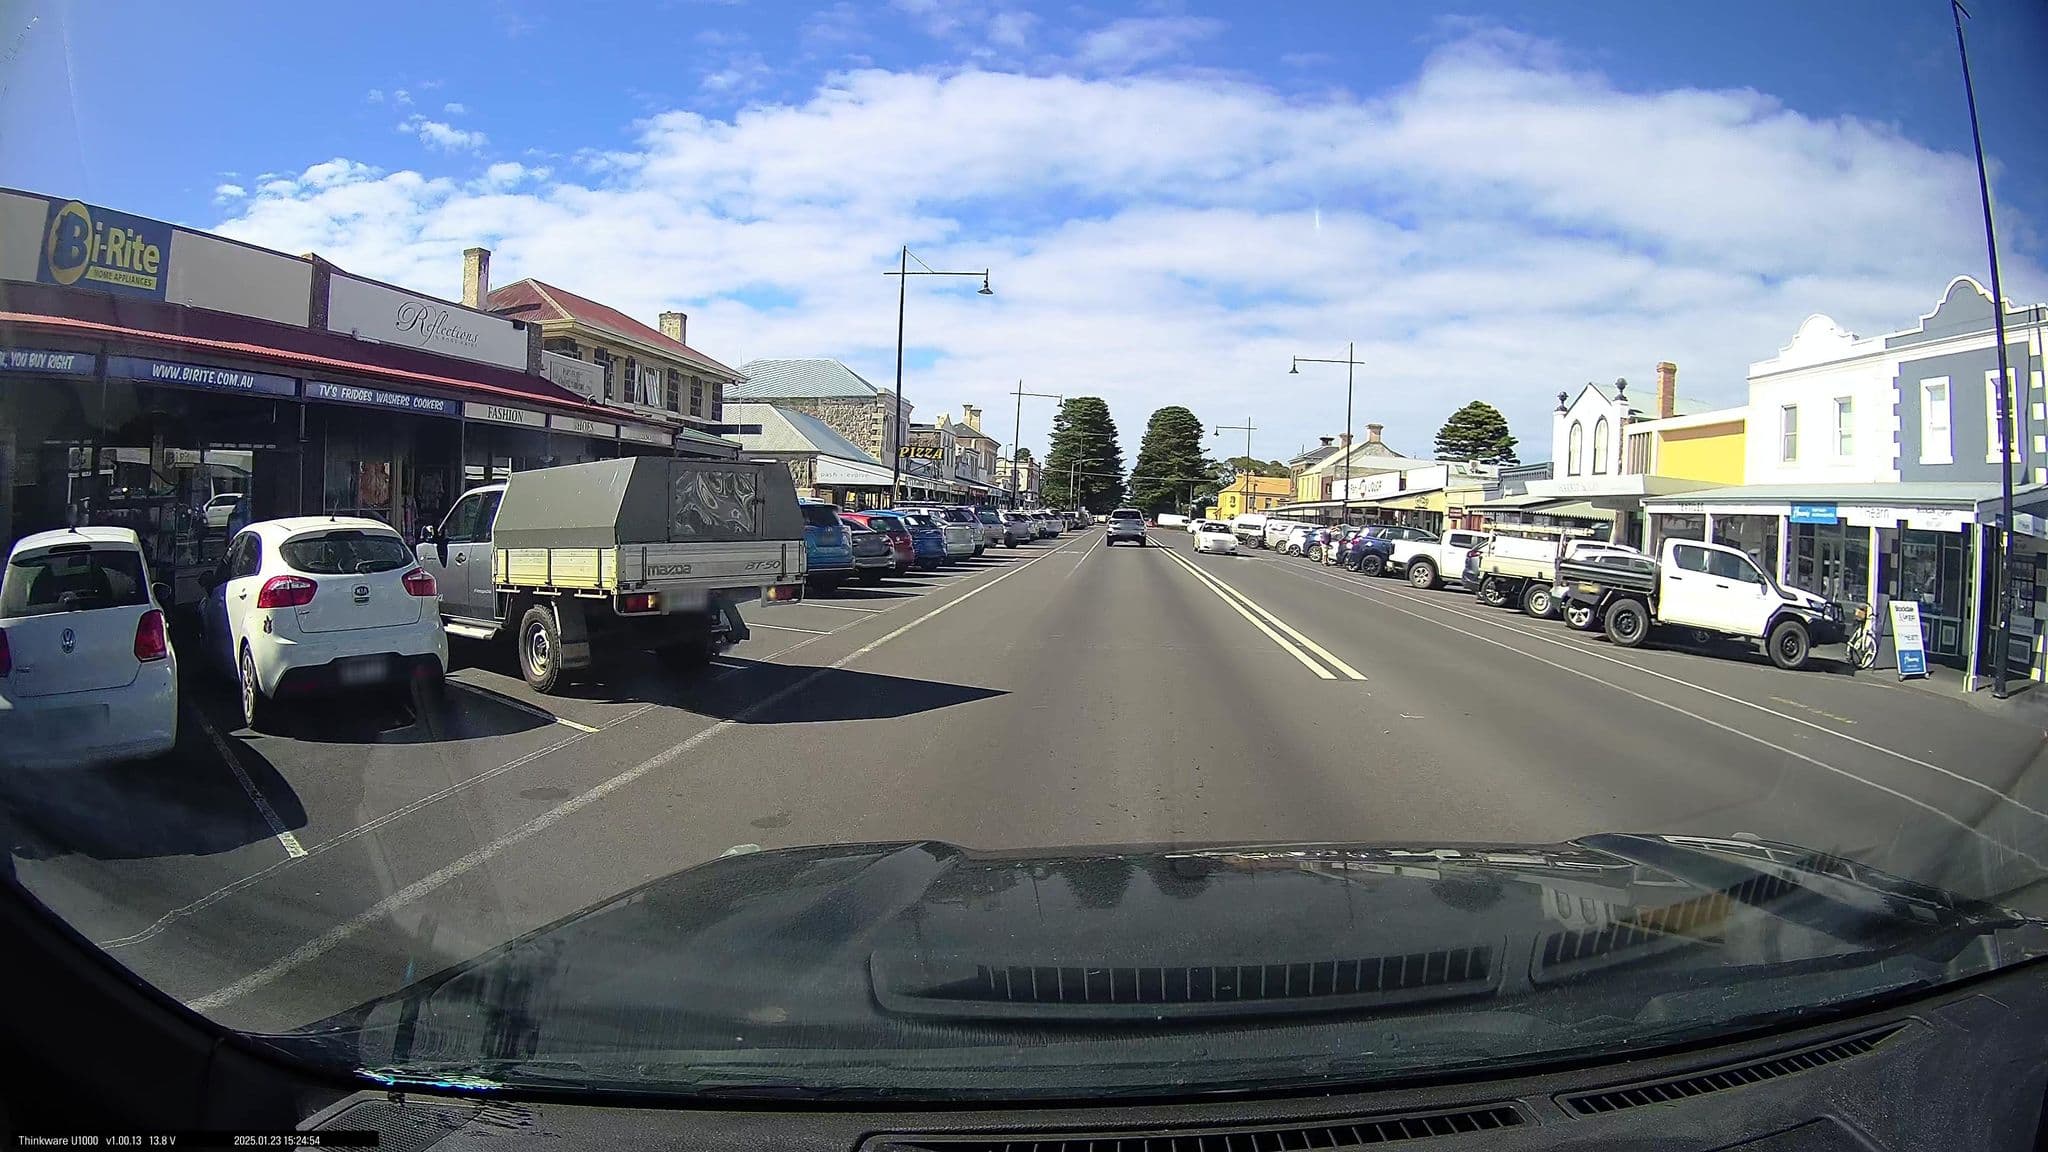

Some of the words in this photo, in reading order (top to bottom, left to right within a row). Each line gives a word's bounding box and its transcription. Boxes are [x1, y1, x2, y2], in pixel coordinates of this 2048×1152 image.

[50, 205, 160, 275] Bi-Rite
[113, 272, 153, 288] APPLIANCES
[395, 301, 479, 347] Reflections
[10, 351, 28, 367] YOU
[28, 352, 47, 369] BUY
[47, 354, 75, 370] RIGHT
[152, 363, 254, 388] WWW.BIRITE.COM.AU
[319, 384, 338, 398] TV'S
[340, 387, 373, 402] FRIDGES
[376, 392, 411, 407] WASHERS
[413, 397, 444, 411] COOKERS
[487, 406, 524, 423] FASHION
[899, 446, 944, 459] PIZZA
[744, 560, 781, 571] BT-50
